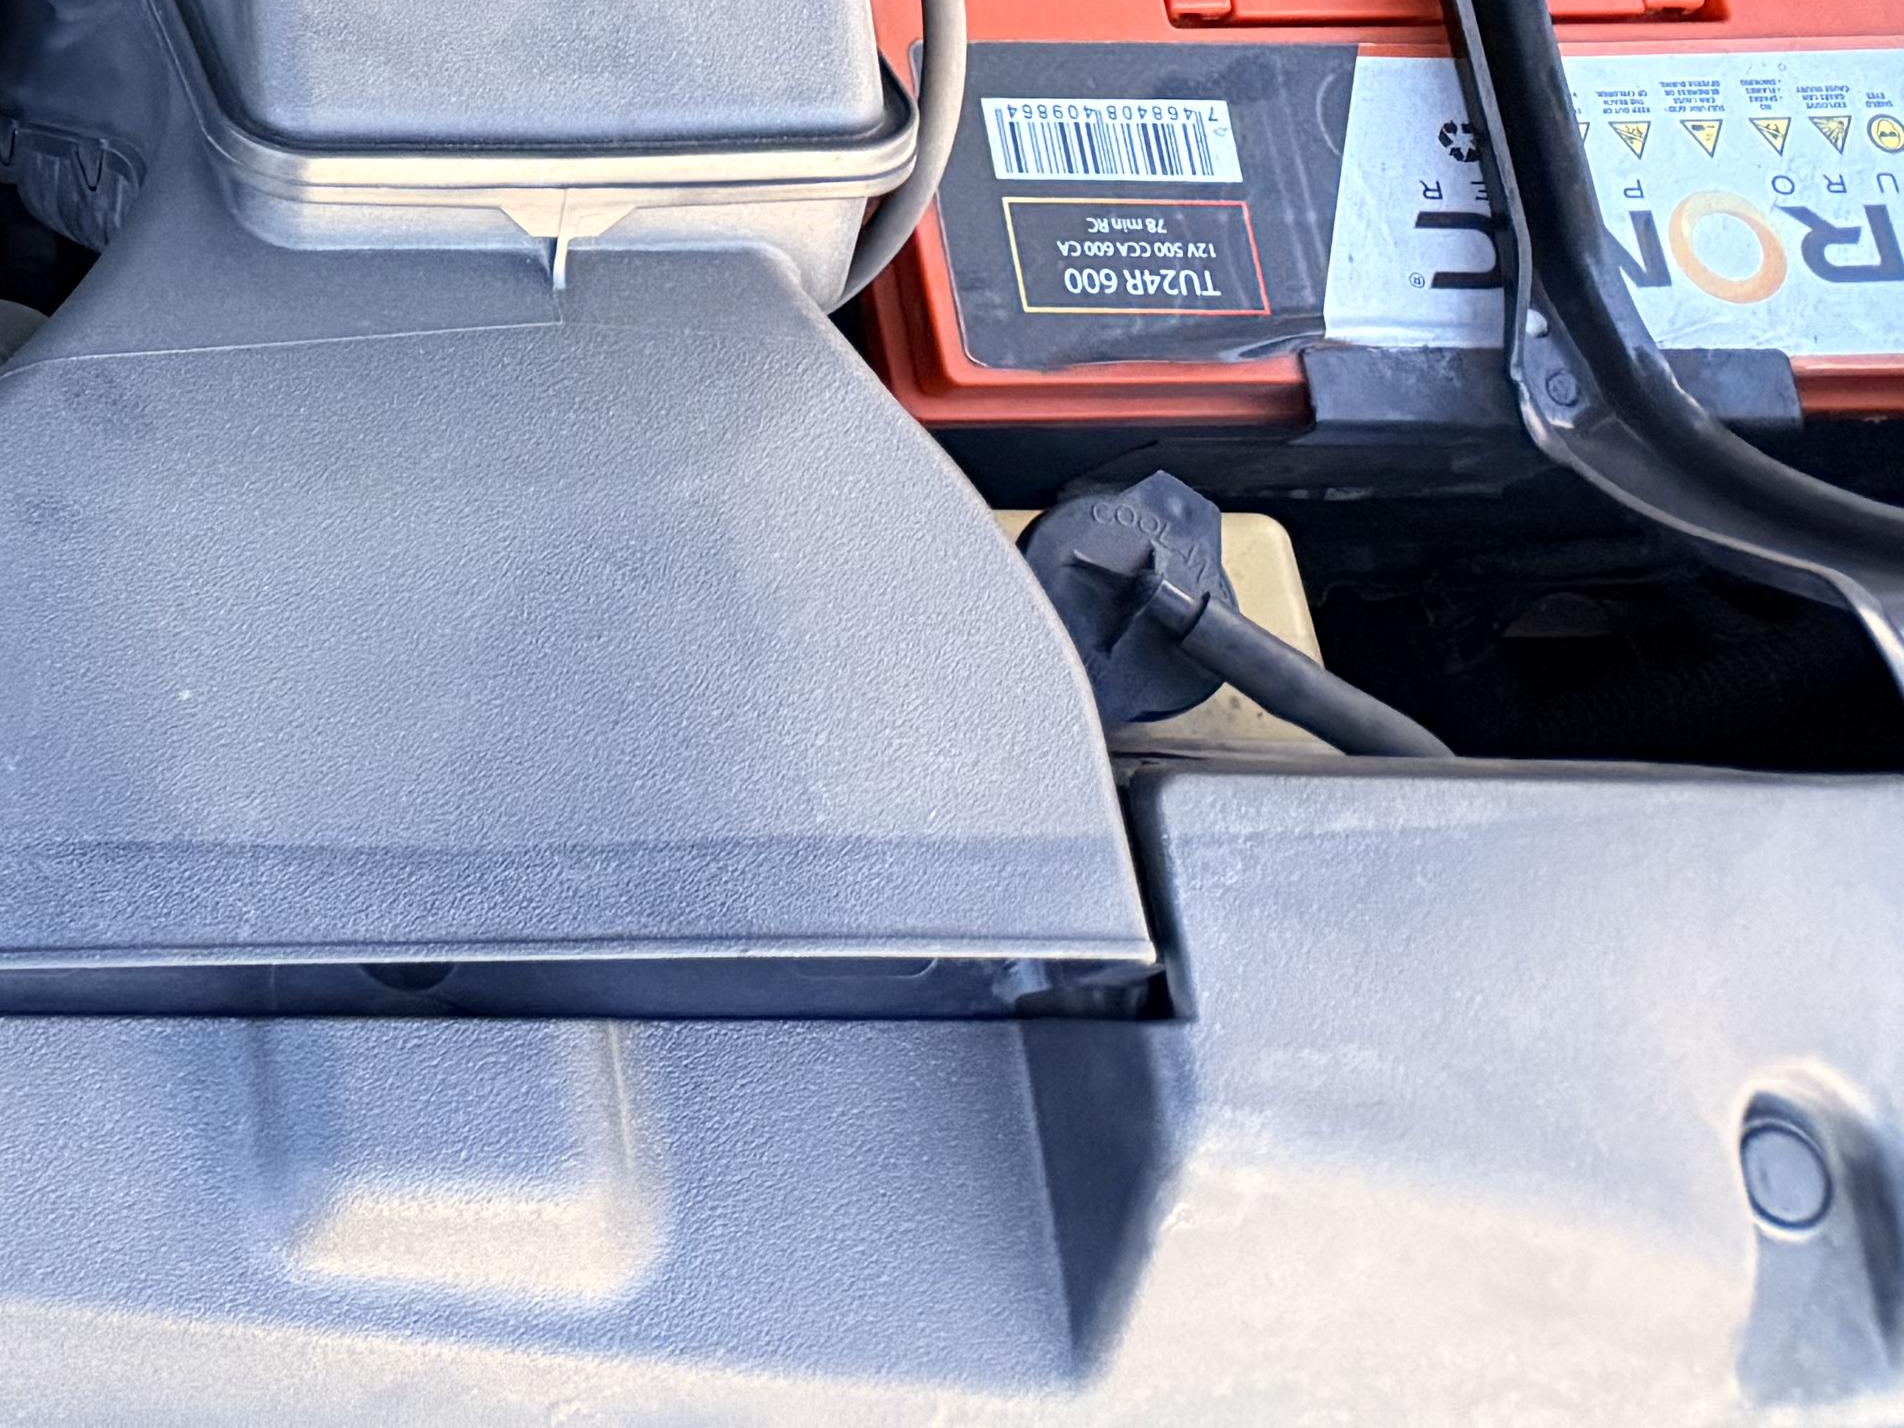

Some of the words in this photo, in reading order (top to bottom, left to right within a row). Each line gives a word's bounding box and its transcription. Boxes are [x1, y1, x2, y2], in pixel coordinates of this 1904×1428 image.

[1085, 217, 1109, 233] RC
[1111, 218, 1143, 234] min
[1145, 218, 1167, 234] 78
[1056, 240, 1082, 257] CA
[1084, 240, 1115, 257] 600
[1117, 241, 1152, 257] CCA
[1154, 241, 1184, 258] 500
[1187, 242, 1217, 258] 12V
[1064, 267, 1118, 295] 600
[1127, 267, 1222, 297] TU24R
